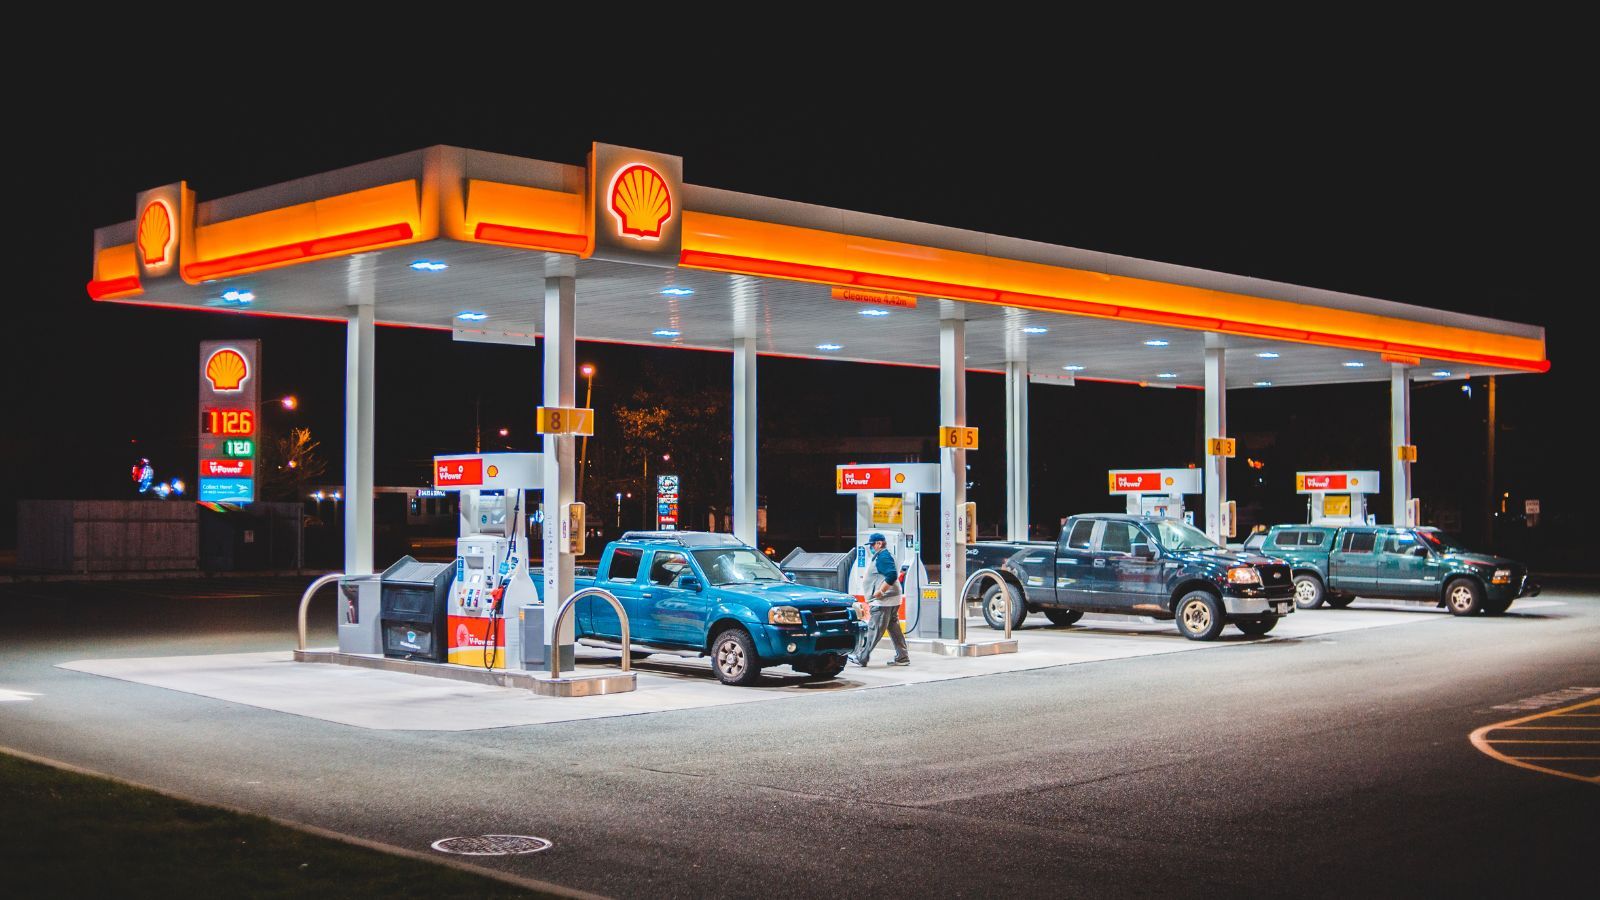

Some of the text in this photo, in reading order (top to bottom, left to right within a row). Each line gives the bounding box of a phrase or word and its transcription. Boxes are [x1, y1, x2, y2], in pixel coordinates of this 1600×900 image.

[843, 289, 882, 303] Clearance
[551, 411, 561, 430] 8
[575, 412, 586, 431] 7
[950, 430, 957, 445] 6
[966, 430, 973, 445] 5
[1215, 441, 1221, 453] 4
[1227, 441, 1232, 454] 3
[209, 465, 242, 473] V-Power
[439, 471, 462, 480] V-Power
